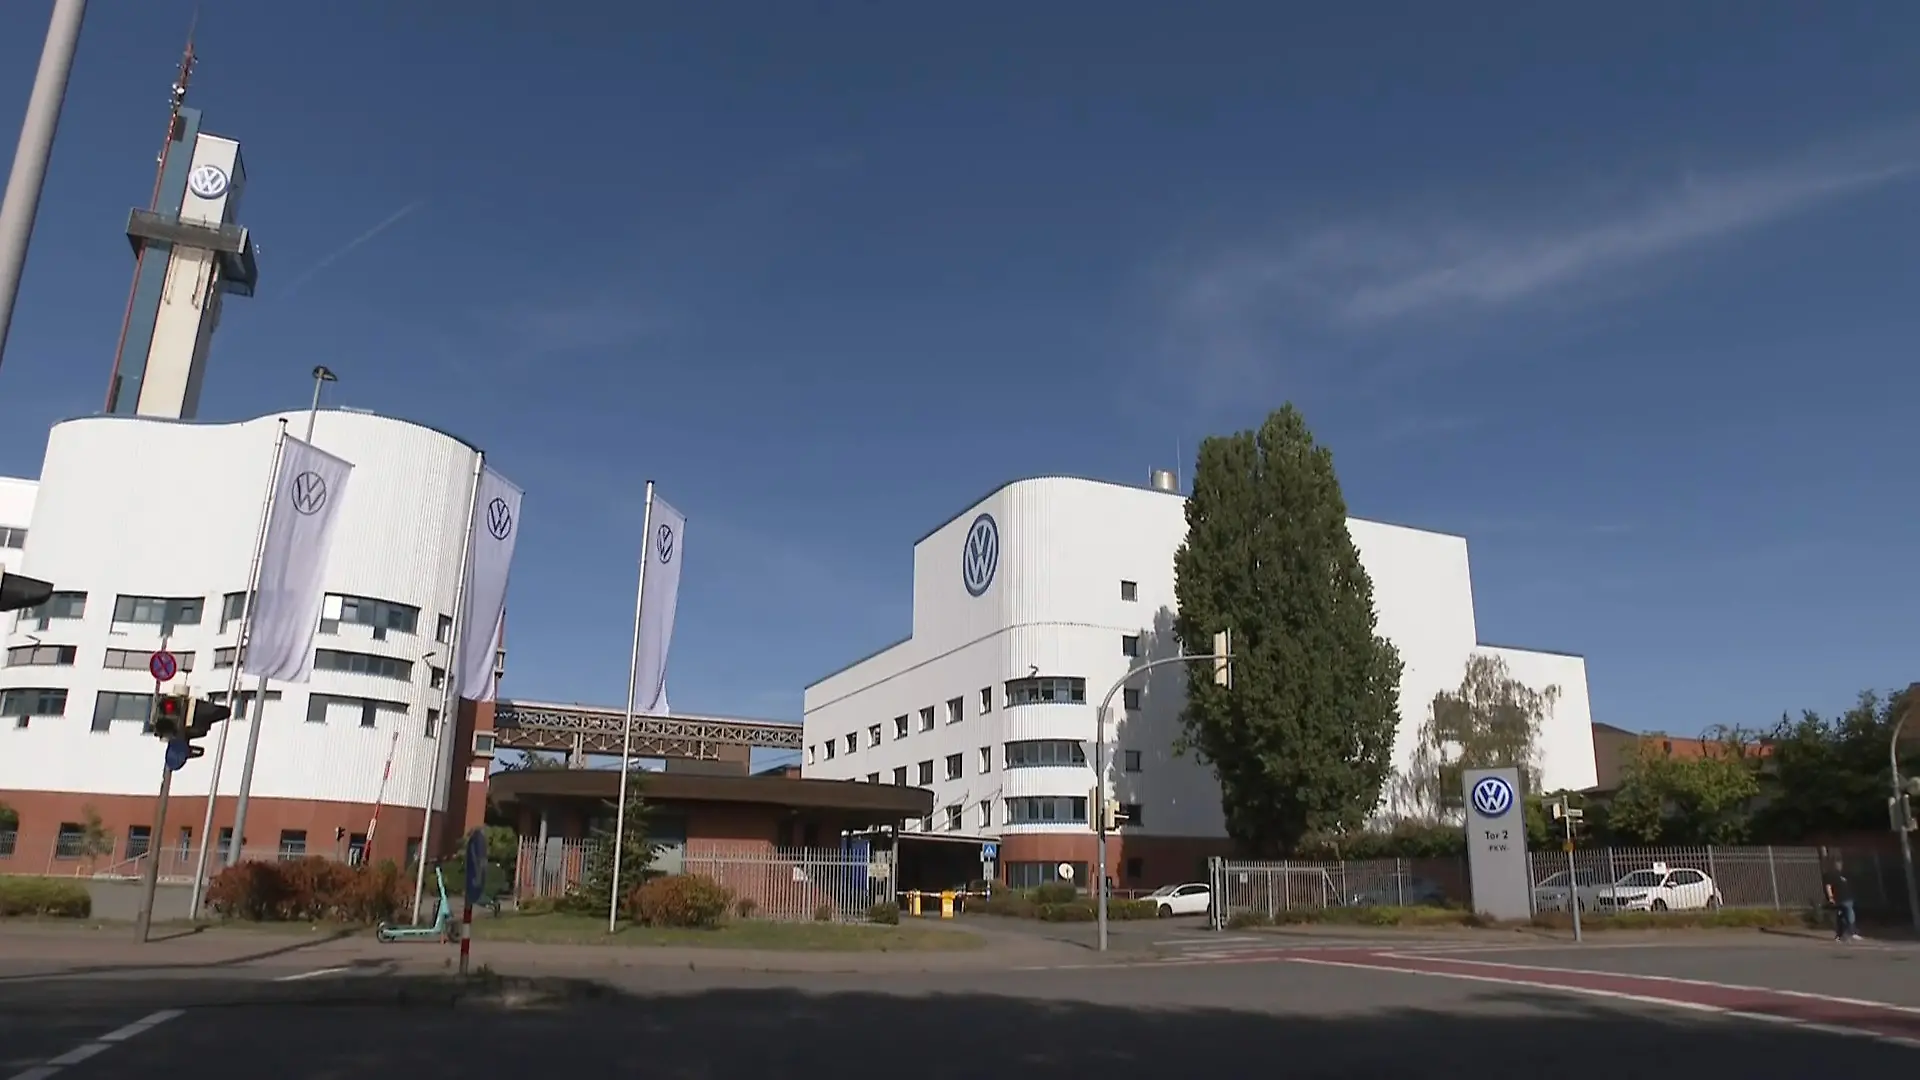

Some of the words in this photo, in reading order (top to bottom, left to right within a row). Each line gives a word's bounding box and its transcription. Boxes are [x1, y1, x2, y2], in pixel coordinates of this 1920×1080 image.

[191, 167, 226, 196] VW
[293, 472, 326, 514] VW
[487, 498, 511, 539] VW
[657, 525, 673, 563] VW
[964, 516, 998, 594] VW
[1473, 778, 1511, 815] VW
[1484, 830, 1499, 840] Tor
[1502, 829, 1509, 840] 2
